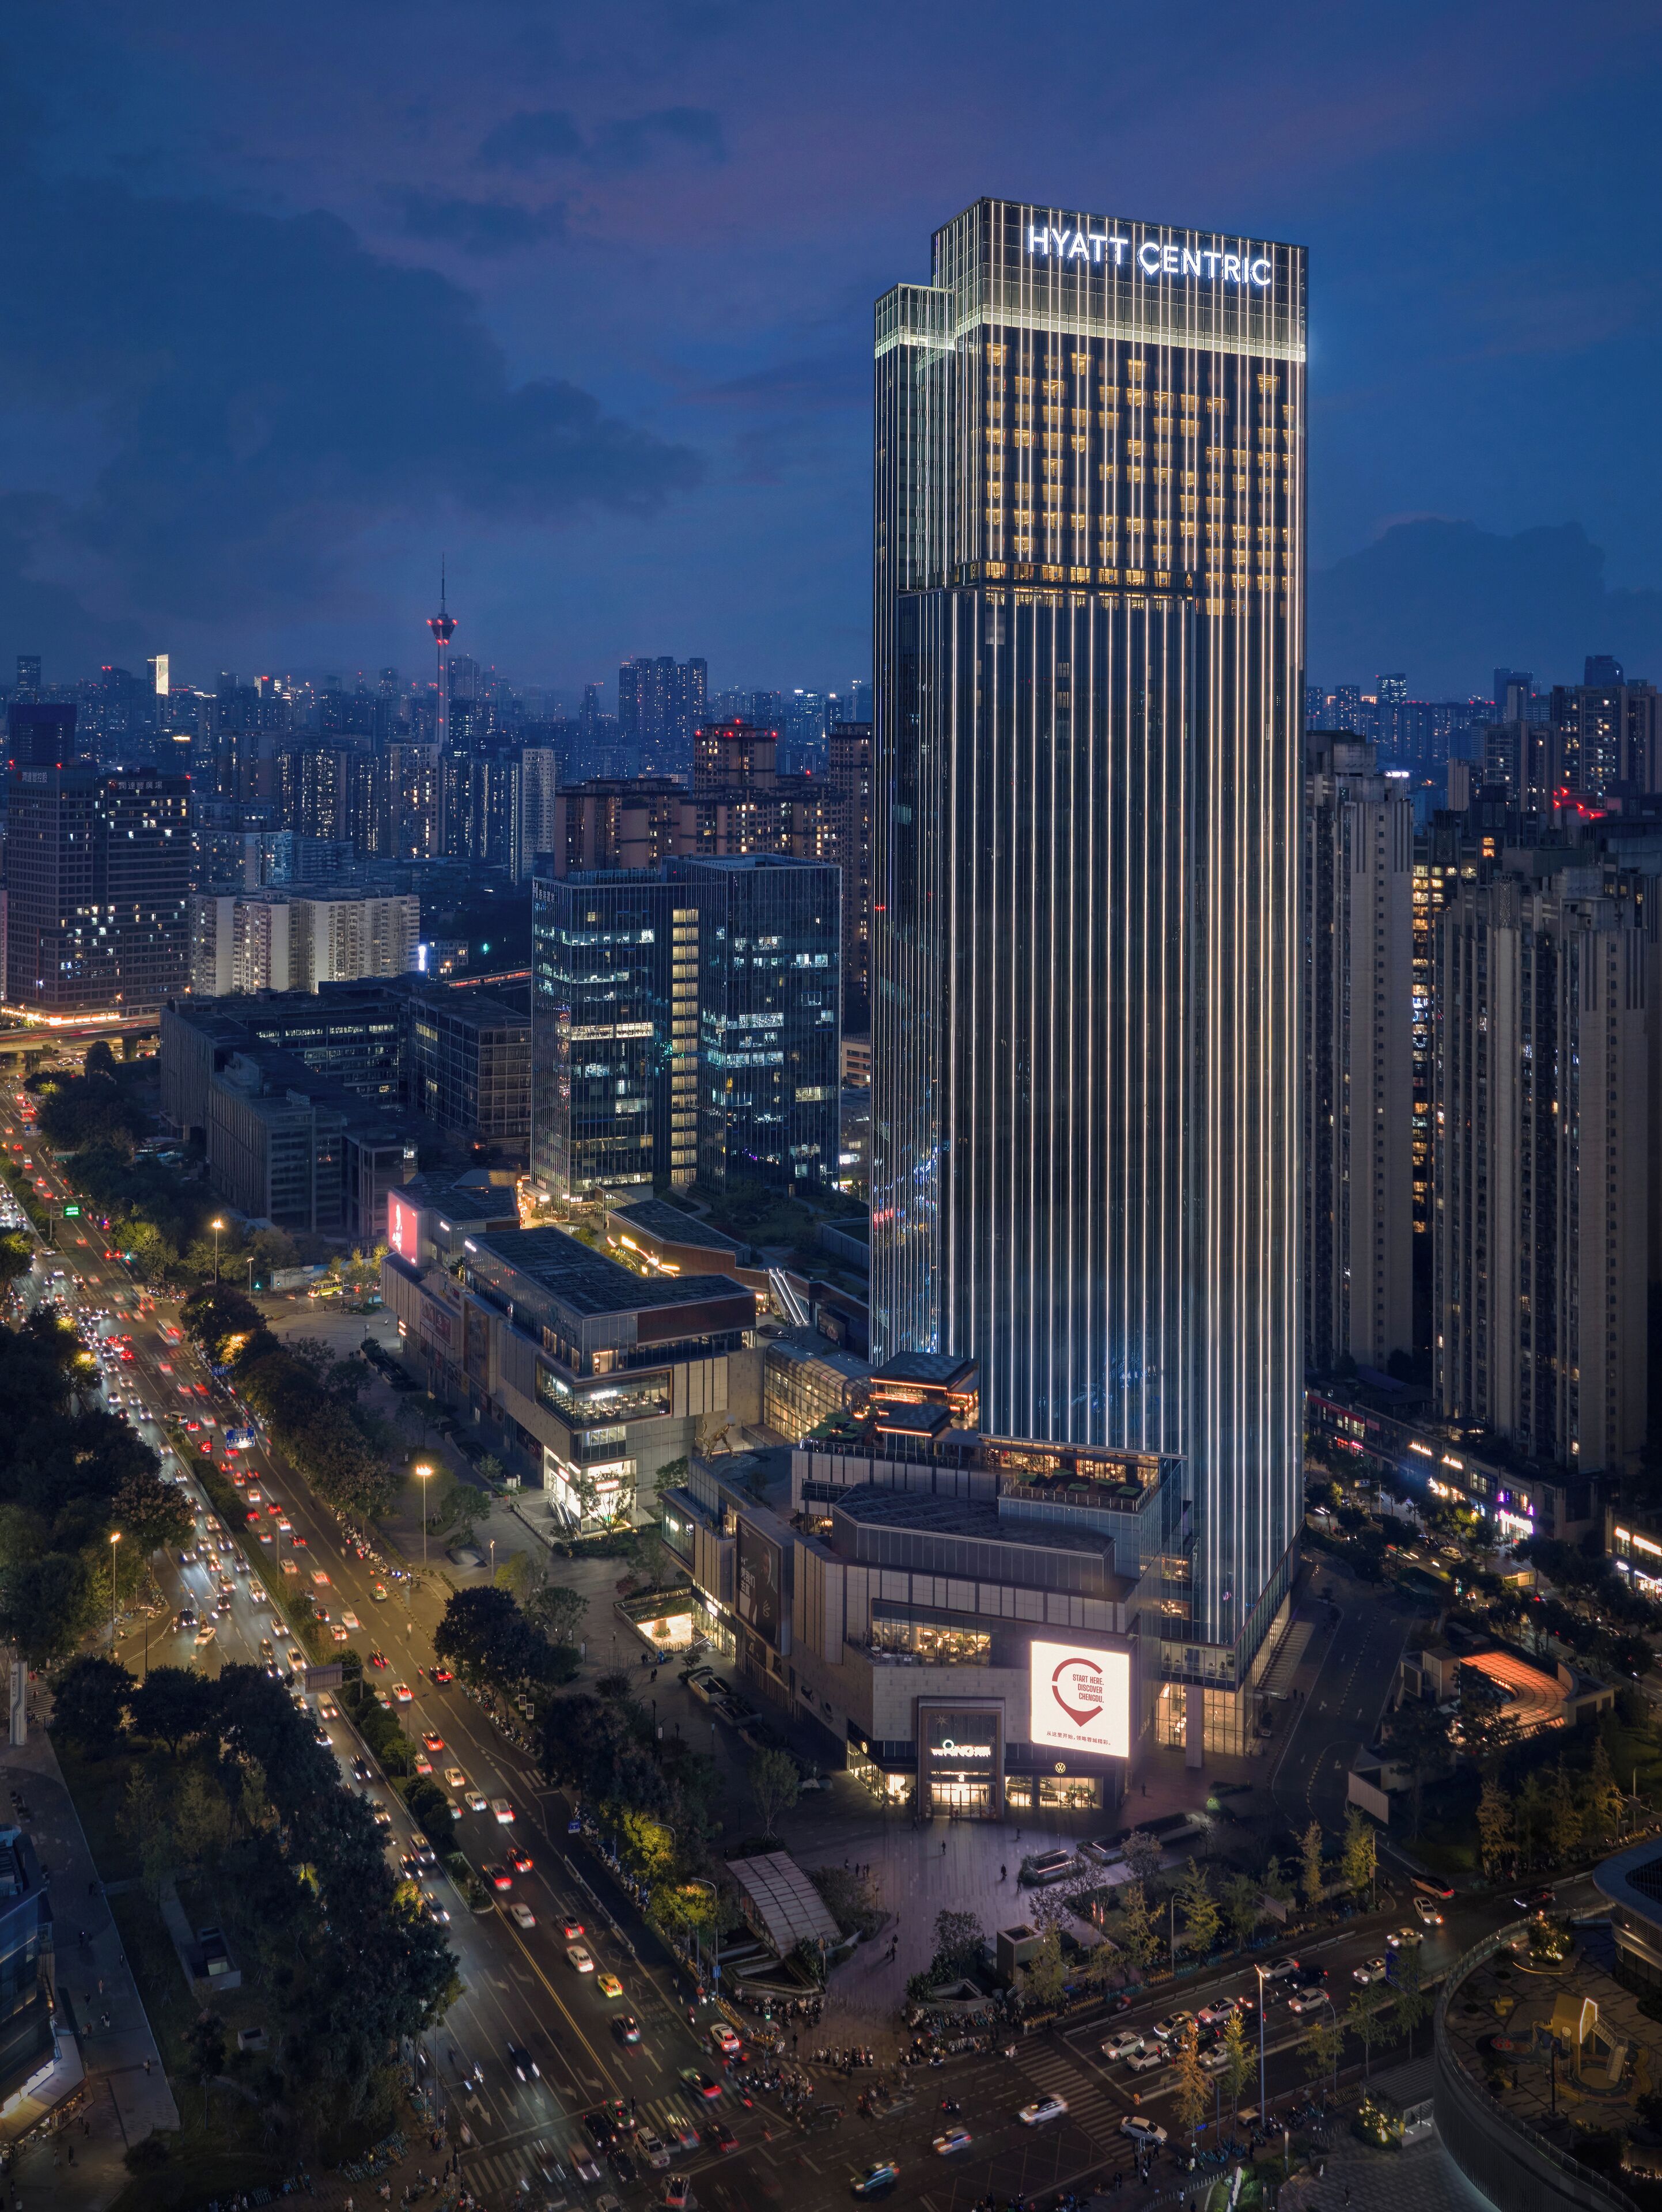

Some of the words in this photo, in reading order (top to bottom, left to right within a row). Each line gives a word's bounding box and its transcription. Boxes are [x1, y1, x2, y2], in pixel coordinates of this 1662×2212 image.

[1028, 225, 1128, 265] HYATT
[1137, 243, 1271, 286] CENTRIC
[1073, 1673, 1088, 1683] START
[1089, 1676, 1104, 1685] HERE.
[1078, 1683, 1103, 1694] DISCOVER
[1078, 1692, 1104, 1703] CHENGDU.
